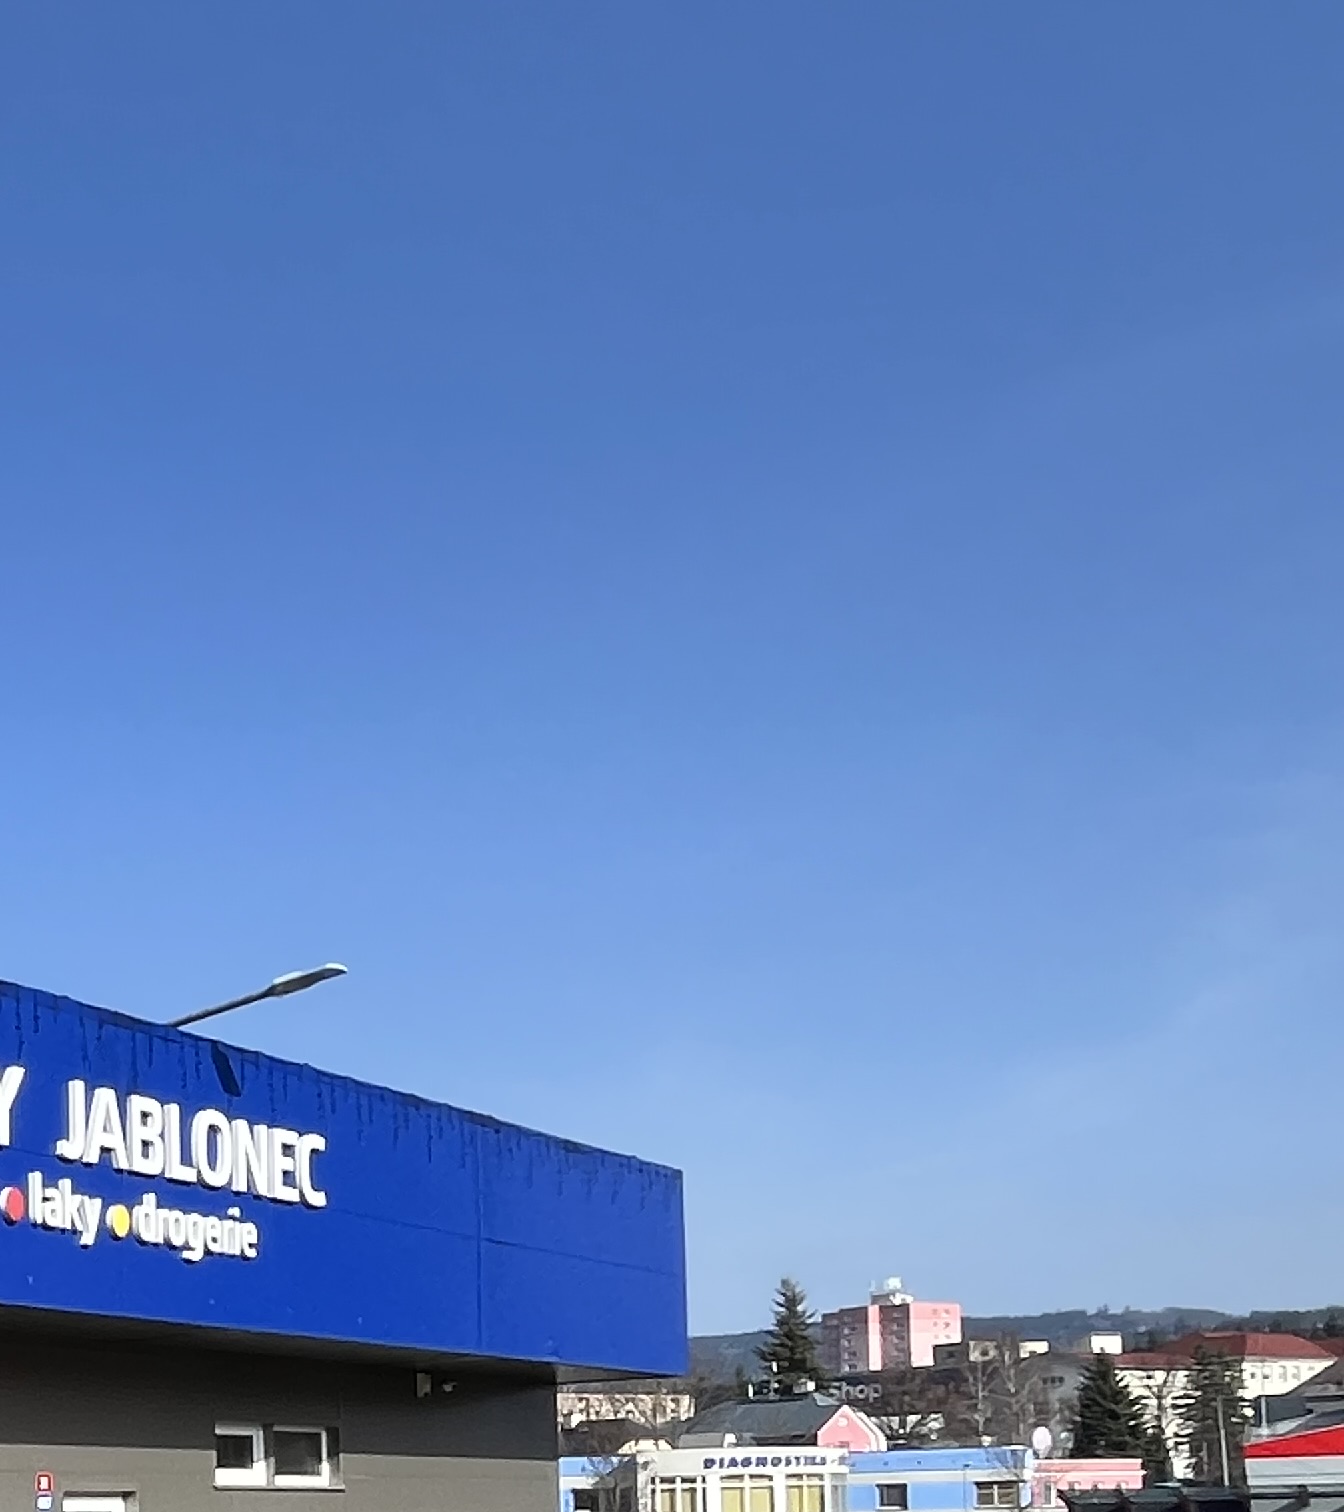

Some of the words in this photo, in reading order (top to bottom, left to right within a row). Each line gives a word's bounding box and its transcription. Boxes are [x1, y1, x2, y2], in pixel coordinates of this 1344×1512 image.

[55, 1078, 327, 1208] JABLONEC
[27, 1170, 102, 1246] laky
[132, 1192, 258, 1262] drogerie
